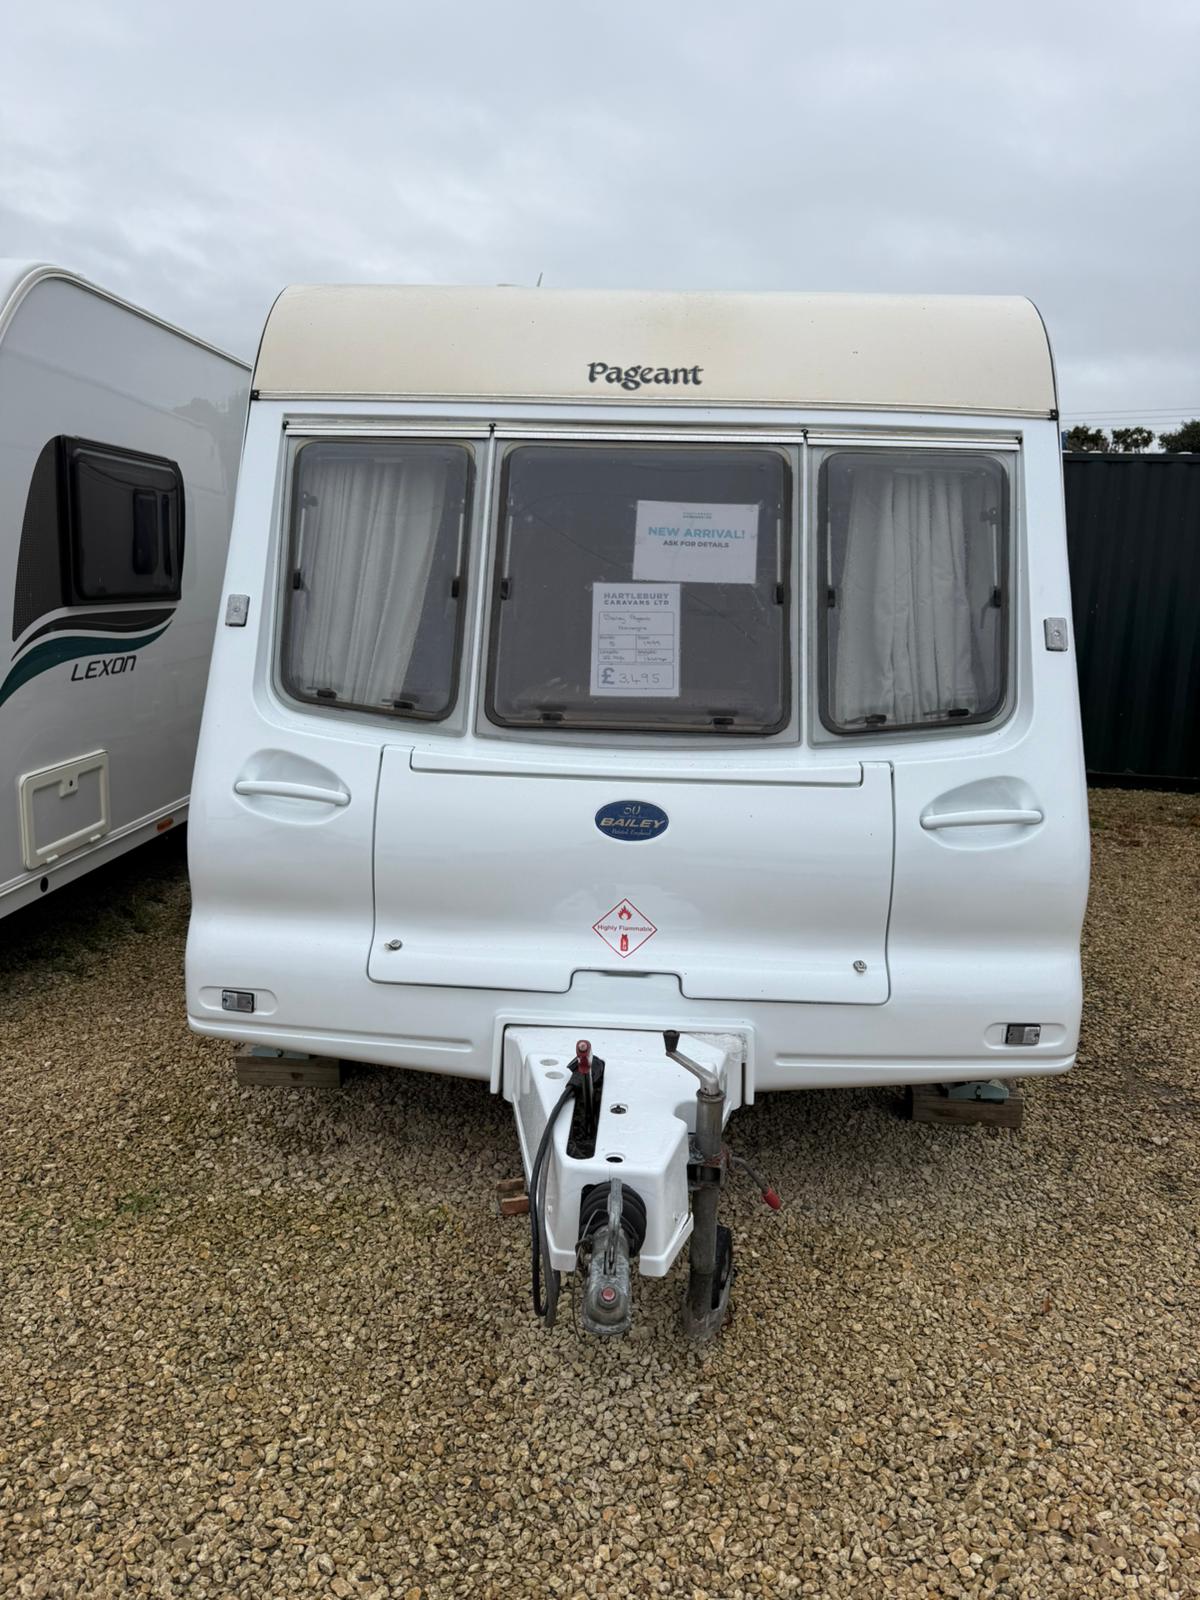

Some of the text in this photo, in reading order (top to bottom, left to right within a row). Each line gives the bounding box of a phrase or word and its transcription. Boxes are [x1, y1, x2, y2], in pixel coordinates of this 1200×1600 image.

[587, 362, 704, 391] Pageant
[648, 526, 745, 539] NEW ARRIVAL!
[603, 592, 670, 600] HARTLEBURY
[71, 655, 137, 681] LEXON
[601, 667, 616, 685] £
[600, 817, 665, 829] BAILEY
